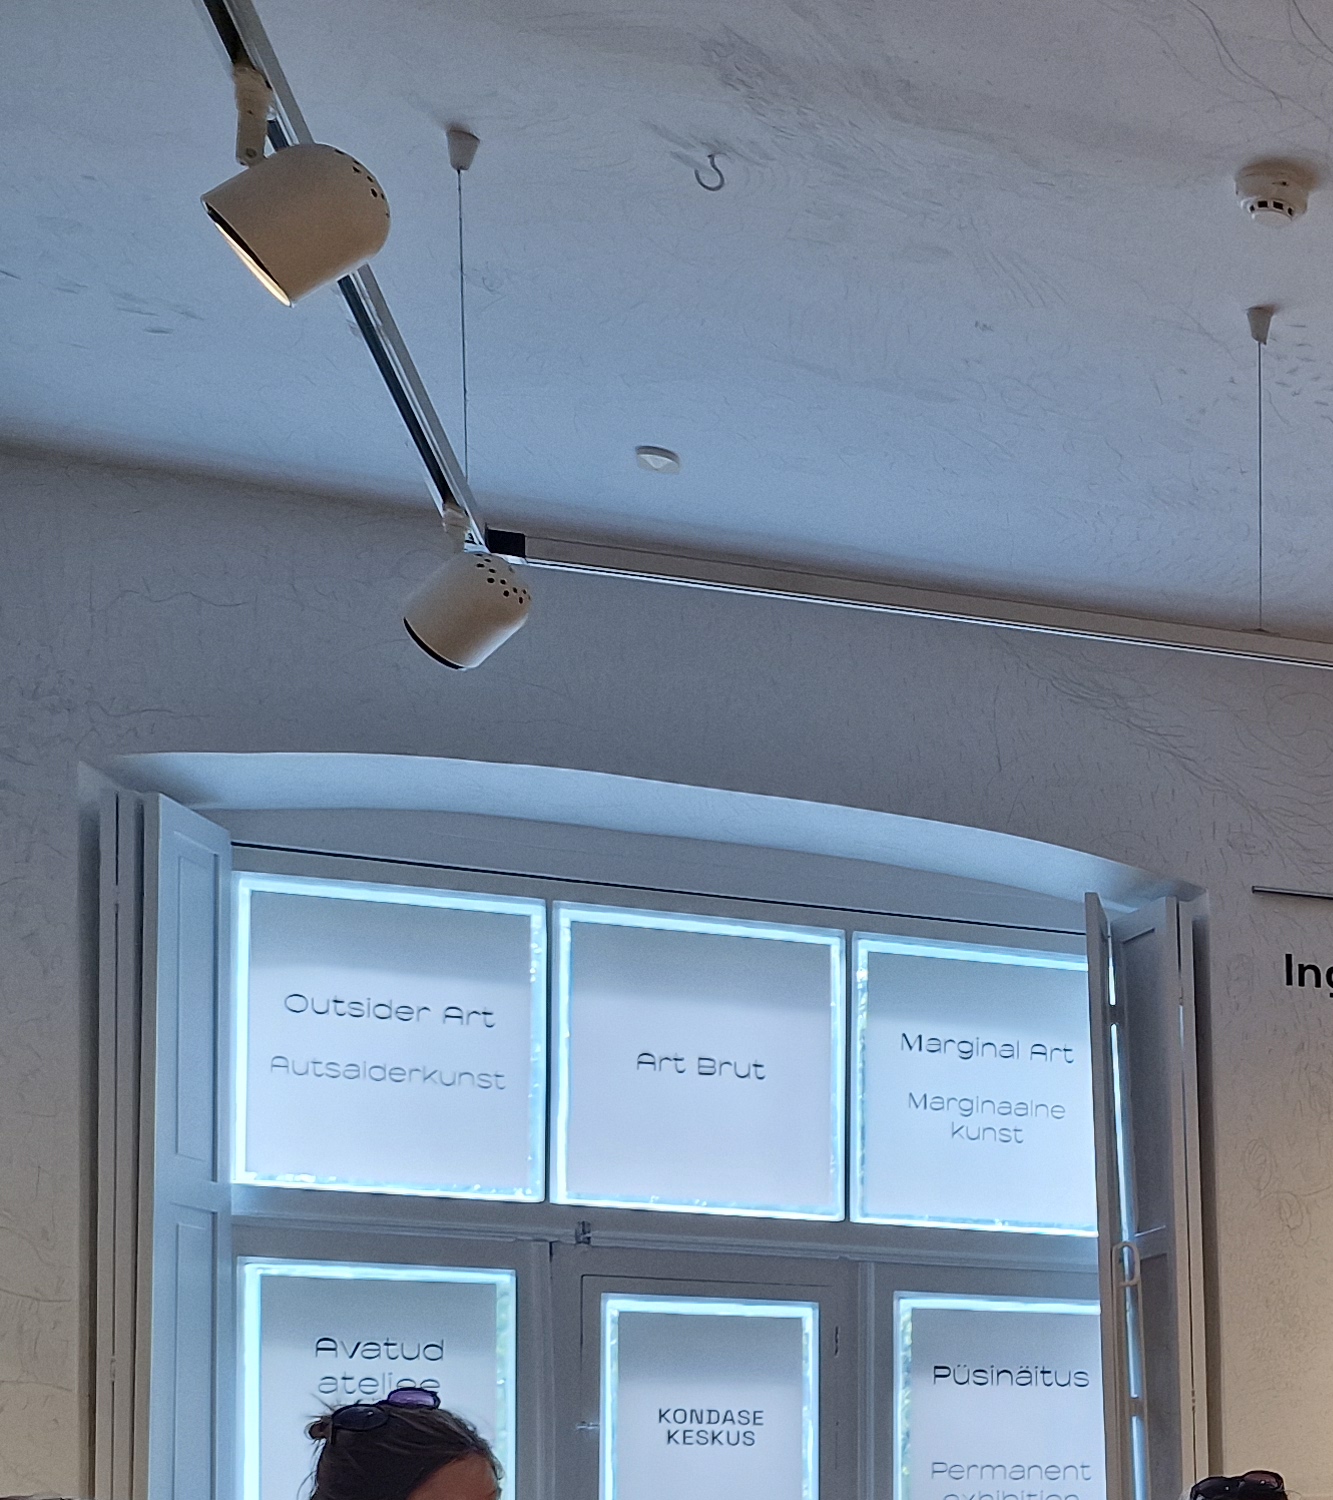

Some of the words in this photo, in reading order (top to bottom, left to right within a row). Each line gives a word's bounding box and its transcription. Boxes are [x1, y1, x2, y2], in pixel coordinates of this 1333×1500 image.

[284, 993, 431, 1022] Outsider
[443, 1005, 496, 1028] Art
[901, 1032, 1019, 1060] Marginal
[1030, 1043, 1074, 1063] Art
[270, 1055, 506, 1090] Autsaiderkunst
[637, 1052, 686, 1074] Art
[698, 1057, 765, 1080] Brut
[951, 1121, 1024, 1144] kunst
[315, 1337, 444, 1361] Avatud
[933, 1364, 1090, 1388] Püsinäitus
[658, 1408, 764, 1426] KONDASE
[667, 1429, 756, 1447] KESKUS
[931, 1461, 1092, 1481] Permanent
